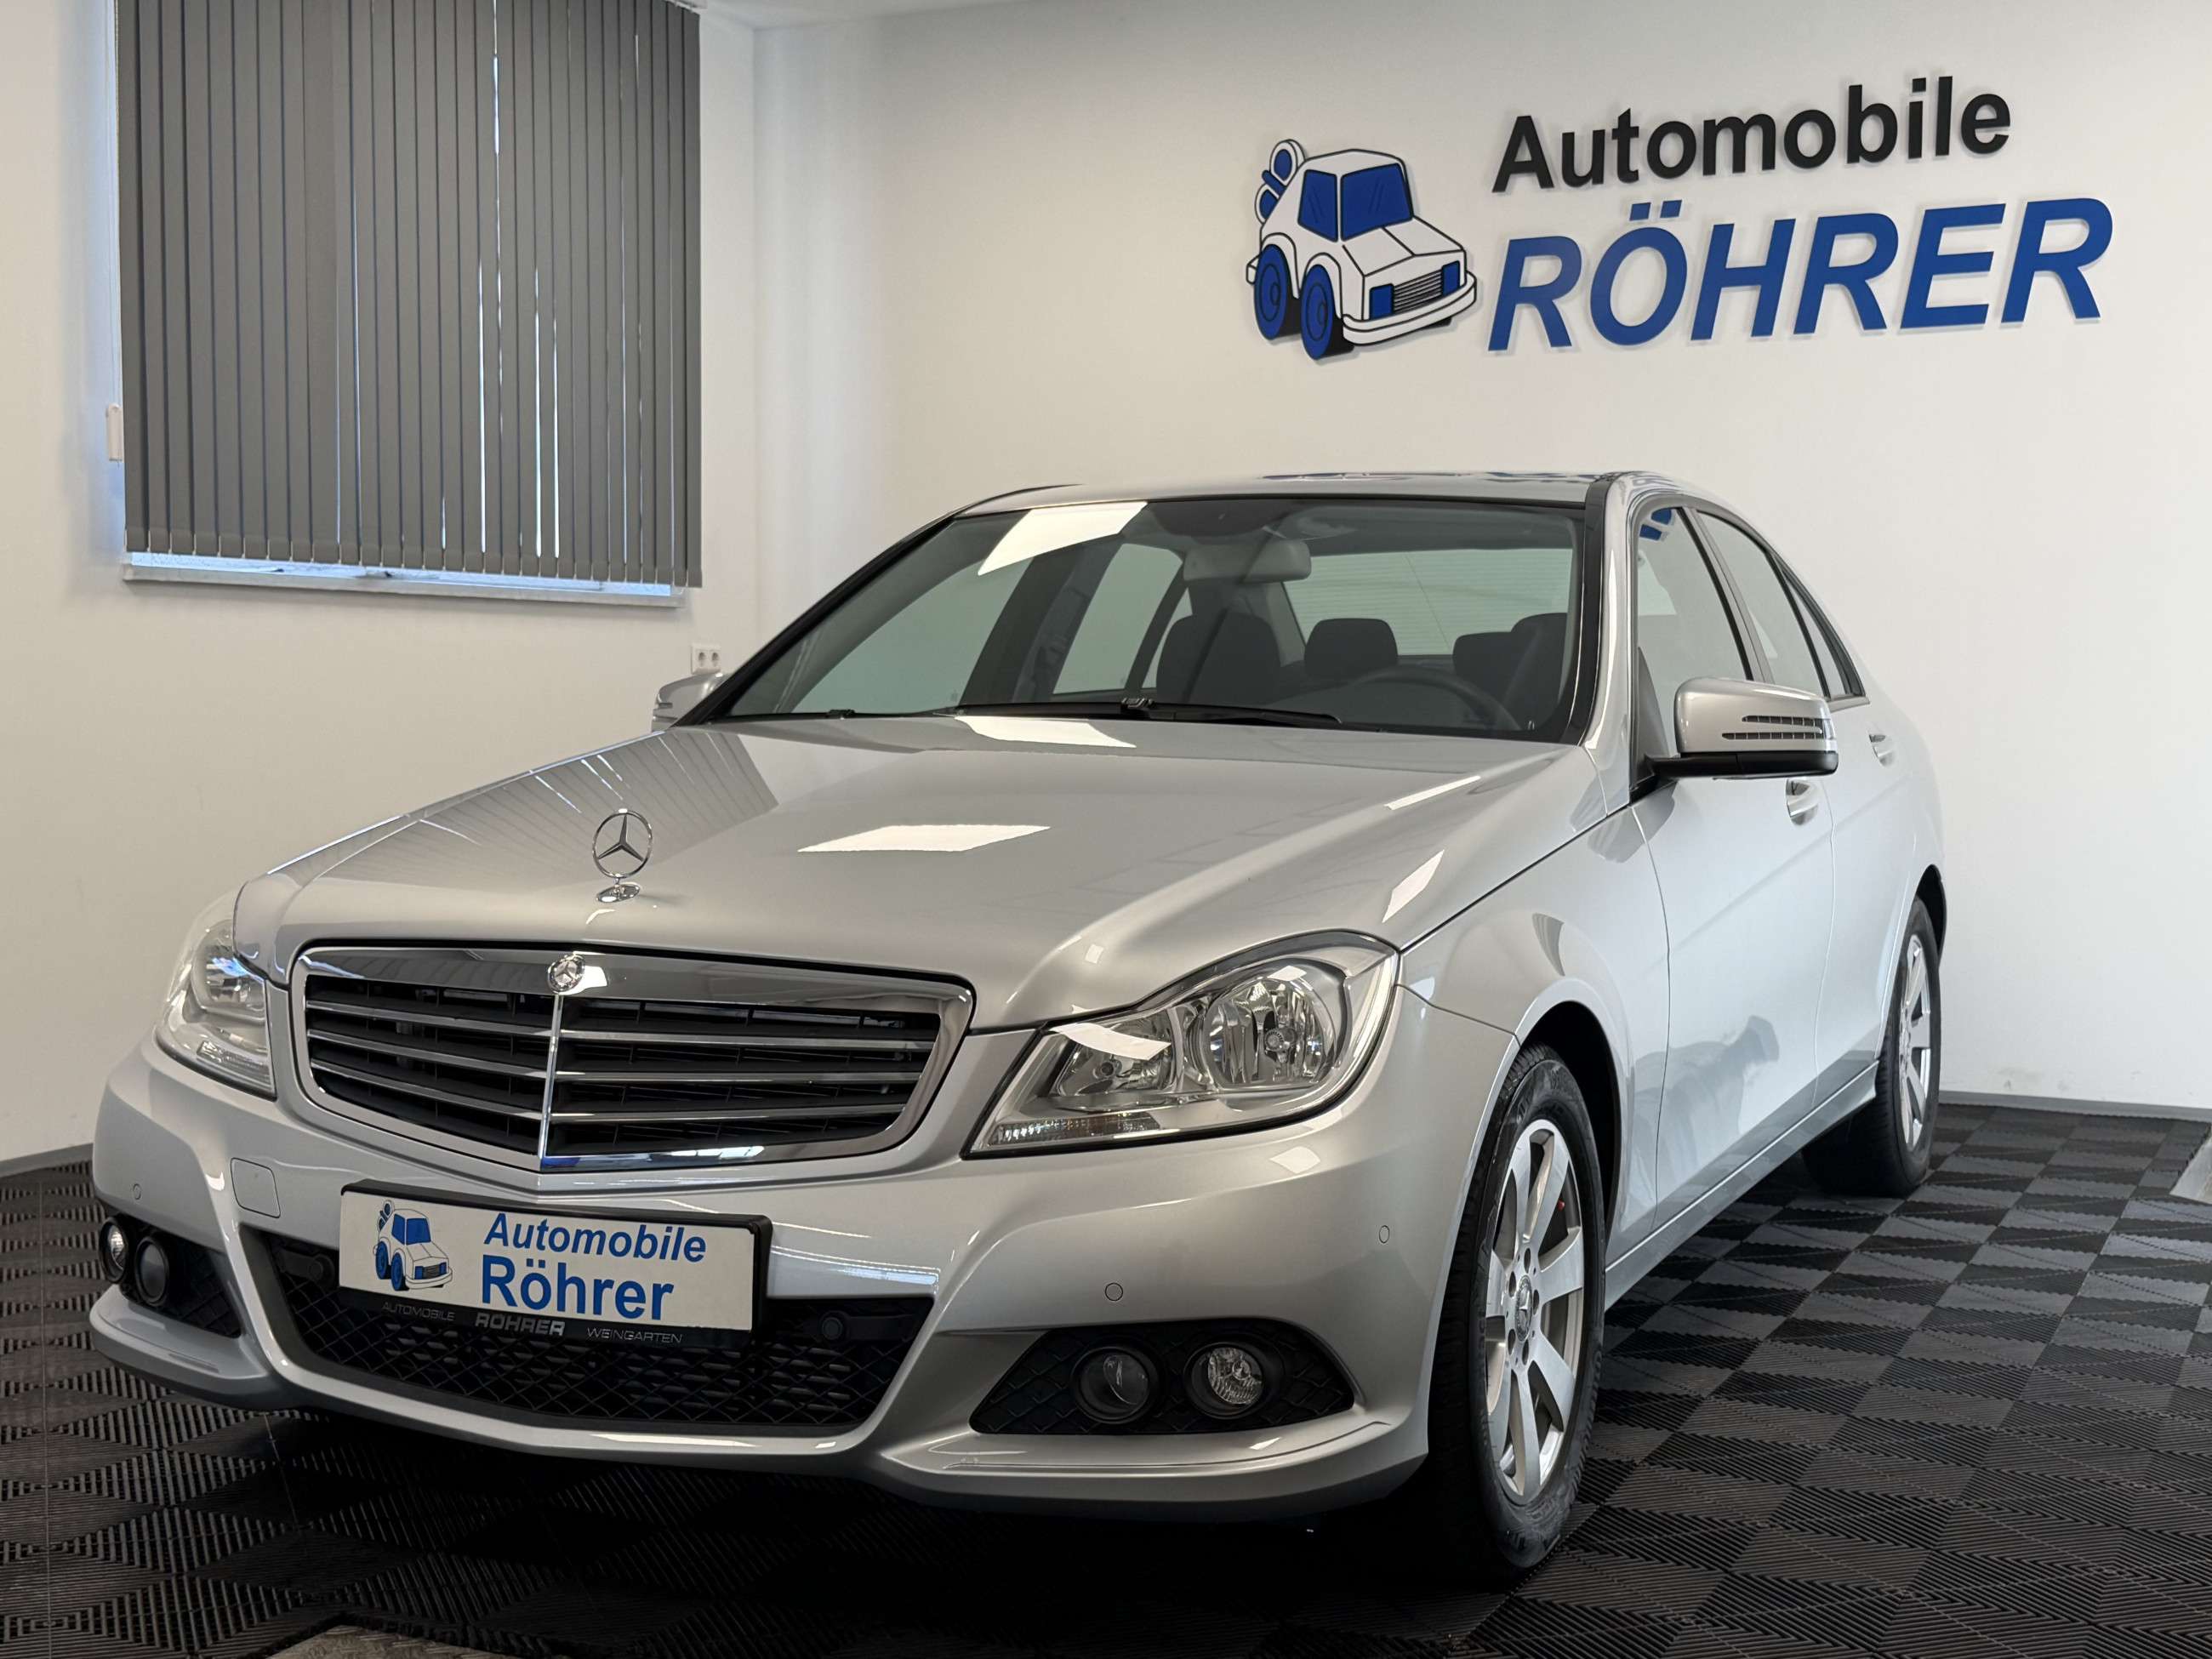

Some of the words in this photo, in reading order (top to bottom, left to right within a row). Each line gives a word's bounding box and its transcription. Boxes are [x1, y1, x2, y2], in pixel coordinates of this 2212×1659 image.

[1492, 75, 2011, 193] Automobile
[1489, 197, 2114, 351] RÖHRER
[482, 1212, 707, 1263] Automobile
[482, 1255, 674, 1321] Röhrer
[380, 1301, 456, 1322] AUTOMOBILE
[586, 1326, 684, 1344] WEINGARTEN
